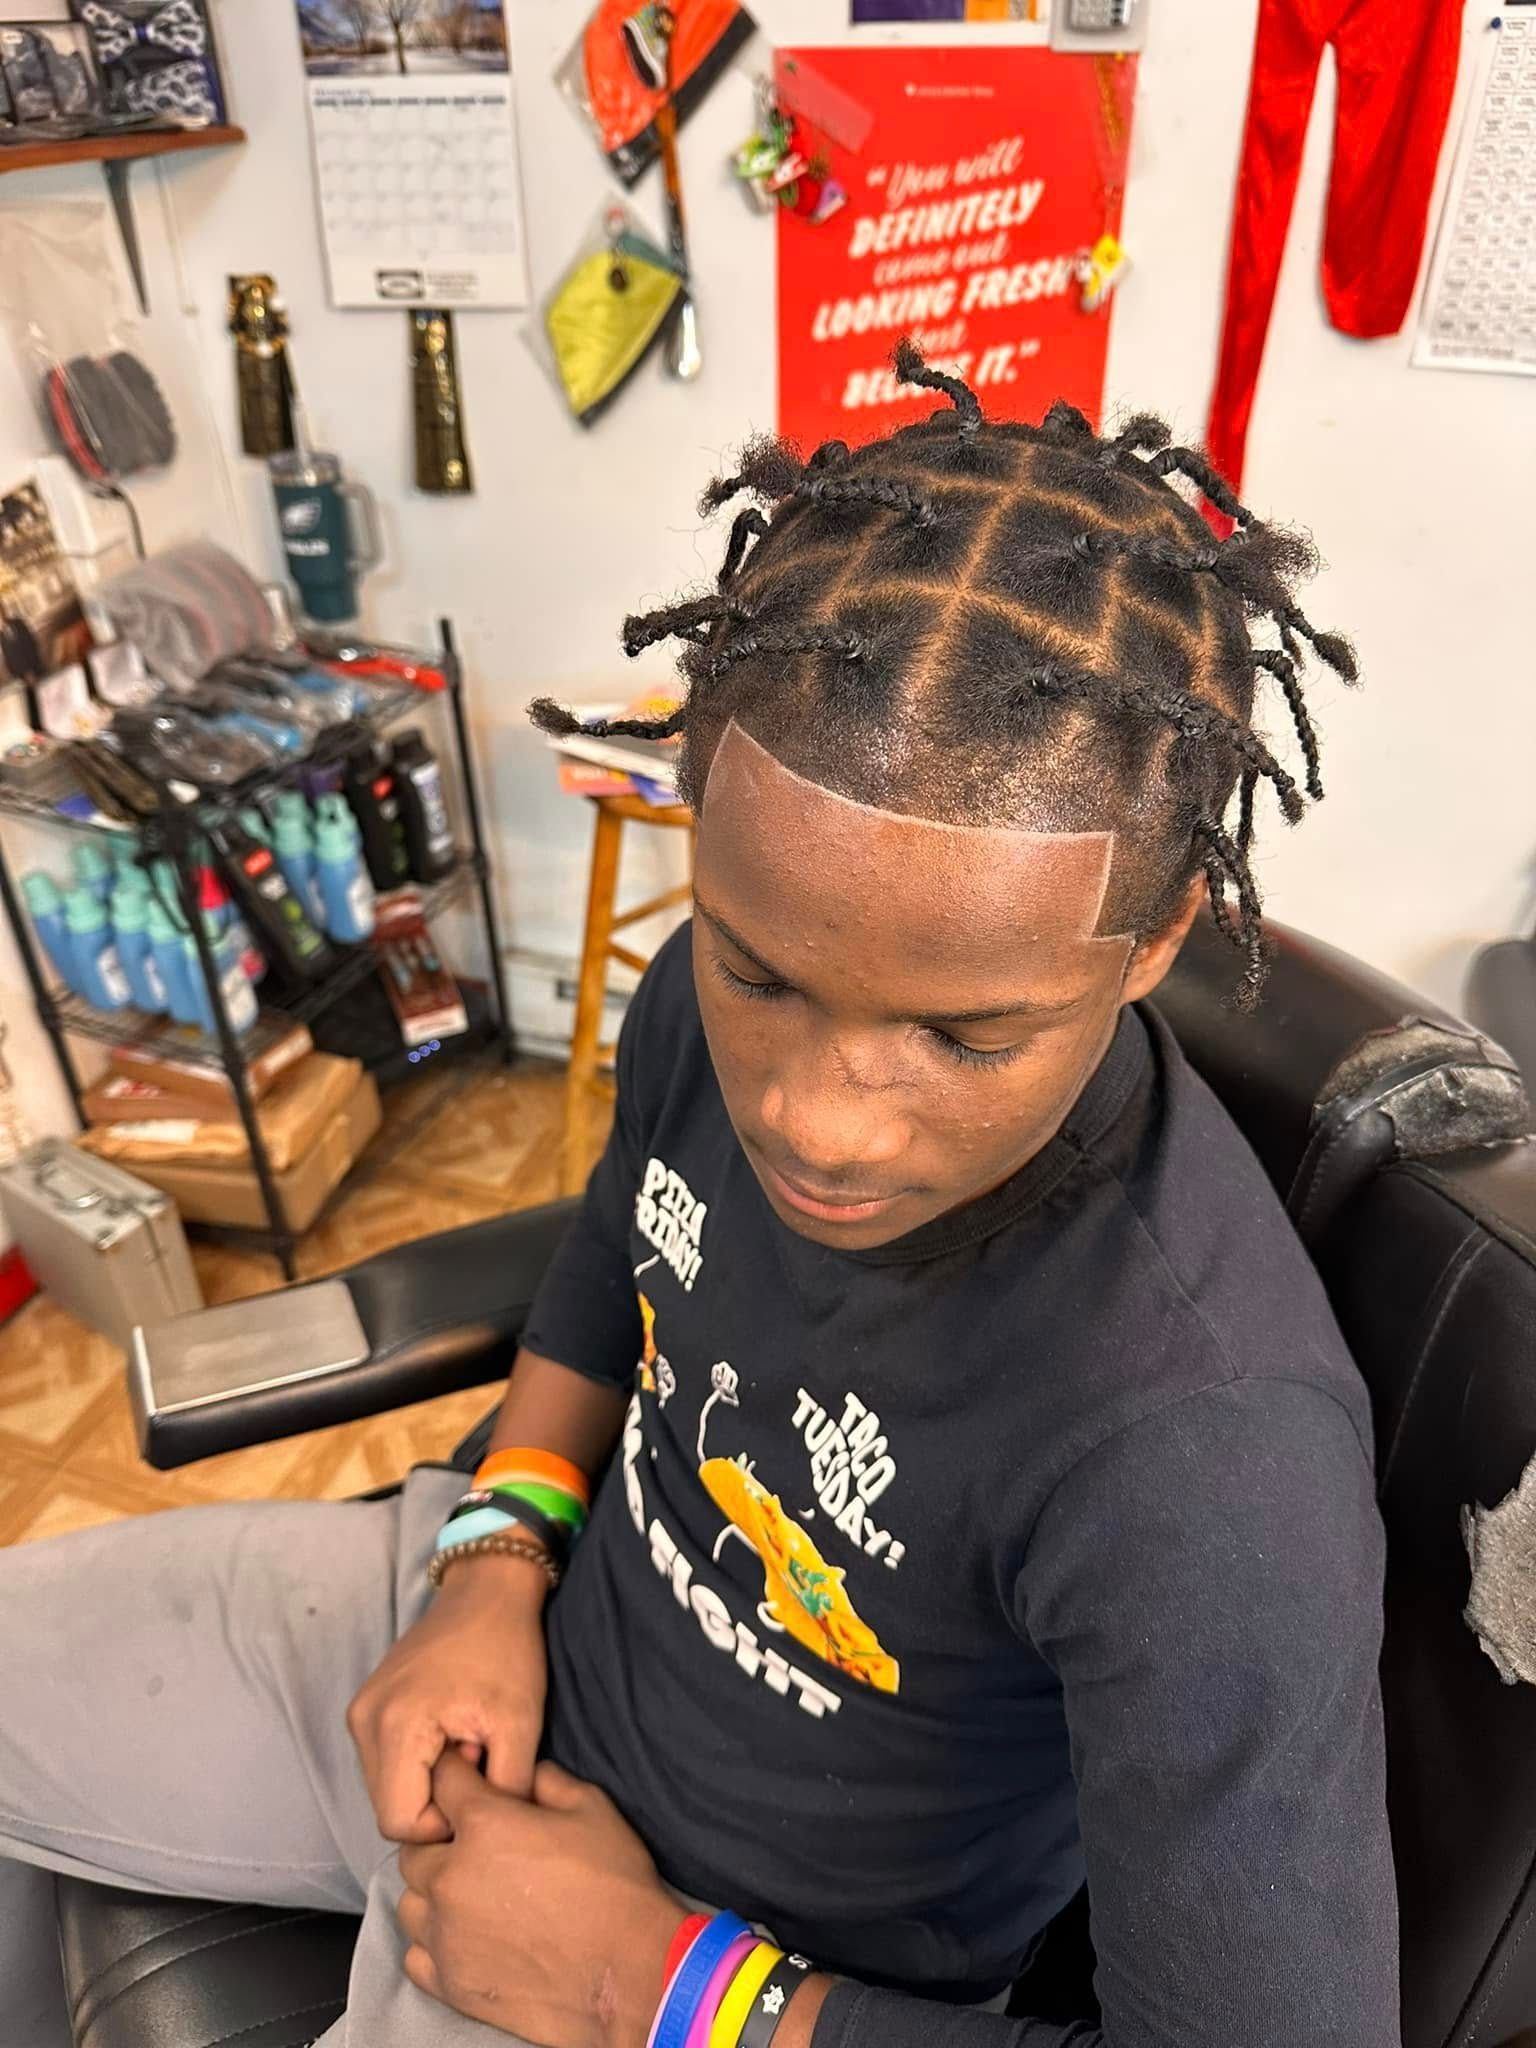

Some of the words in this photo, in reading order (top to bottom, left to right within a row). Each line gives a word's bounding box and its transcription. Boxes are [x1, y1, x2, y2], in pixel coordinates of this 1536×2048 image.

[848, 179, 1045, 260] DEFINITELY
[811, 278, 957, 342] LOOKING
[641, 1157, 707, 1248] PIZZA
[791, 1387, 906, 1571] TUESDAY!
[839, 1391, 897, 1506] TACO
[648, 1517, 842, 1719] FIGHT
